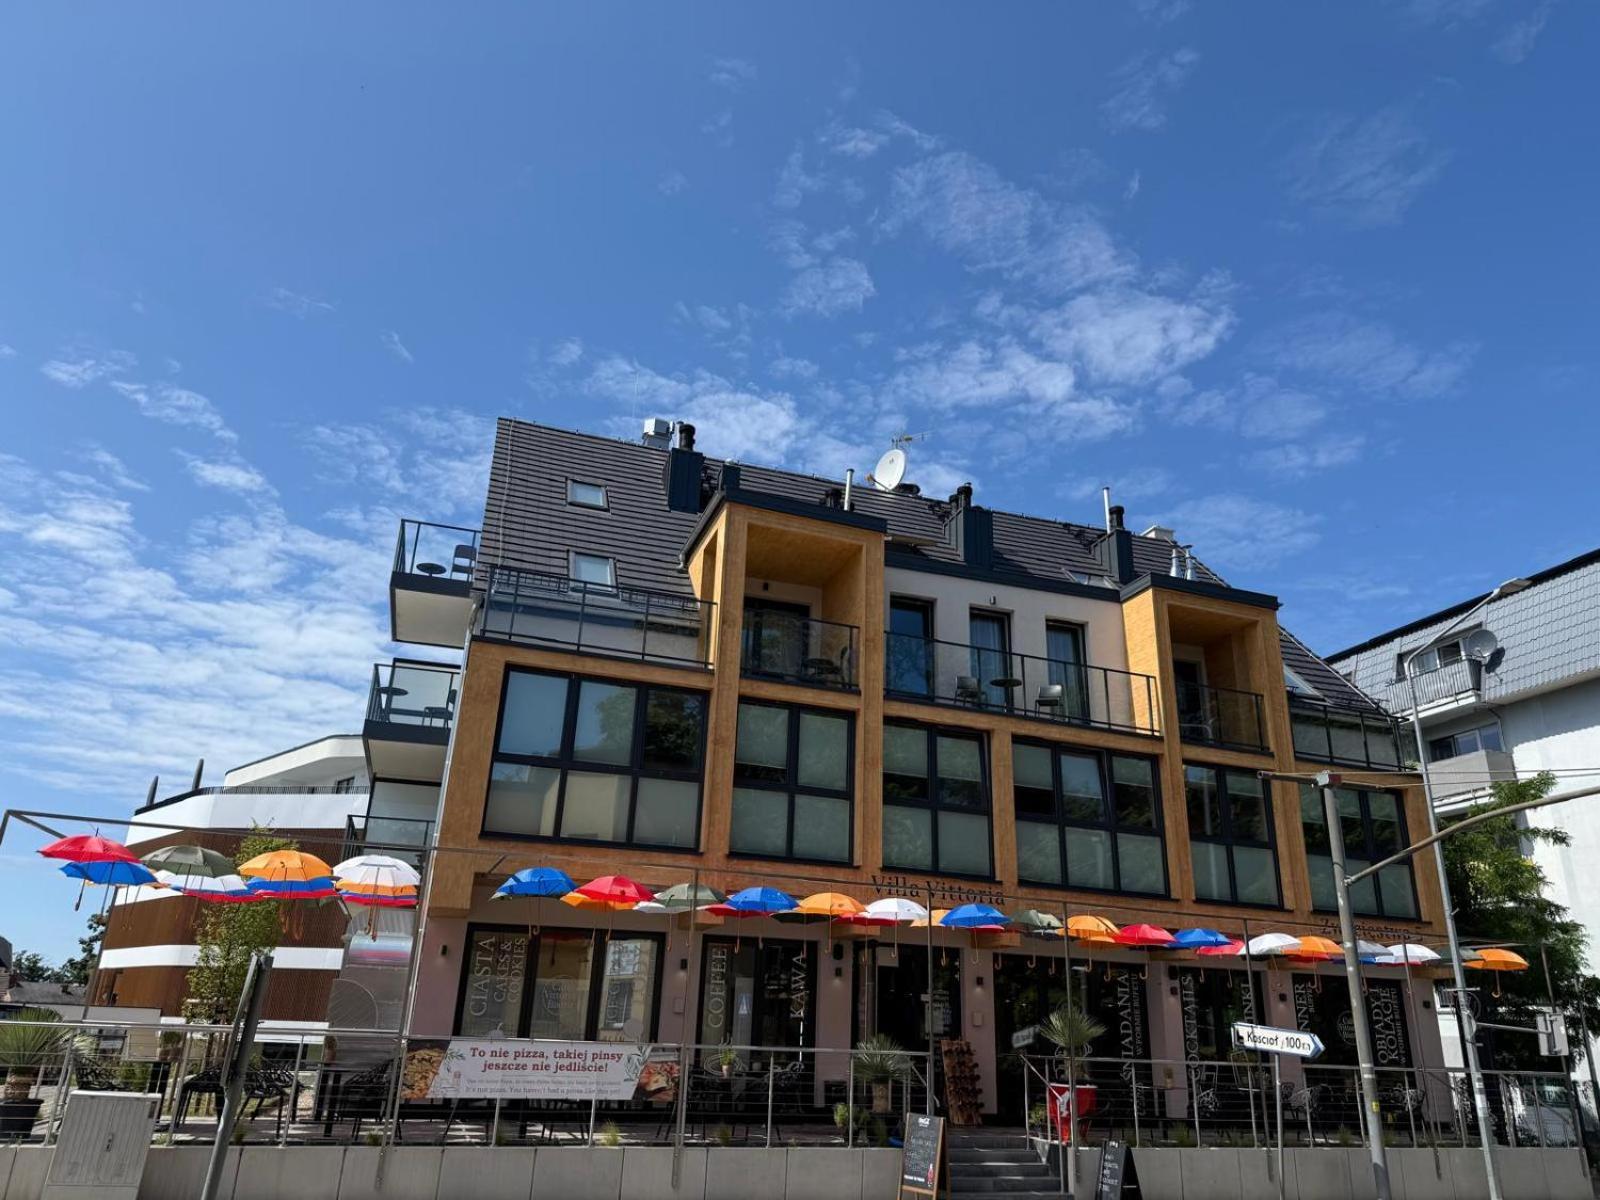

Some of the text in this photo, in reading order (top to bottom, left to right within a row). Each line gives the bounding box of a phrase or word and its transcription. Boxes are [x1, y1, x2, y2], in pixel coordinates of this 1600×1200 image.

[871, 874, 1006, 906] Villa Vittoria
[470, 936, 496, 1016] CIASTA
[493, 940, 512, 1002] CAKES &
[507, 937, 526, 1003] COOKIES
[707, 947, 728, 1028] COFFEE
[789, 953, 808, 1019] KAWA
[470, 1047, 624, 1062] To nie pizza, takiej pinsy
[1181, 976, 1200, 1081] COCKTAILS
[1371, 996, 1389, 1064] OBIADY
[482, 1060, 608, 1073] jeszcze nie jedliście!
